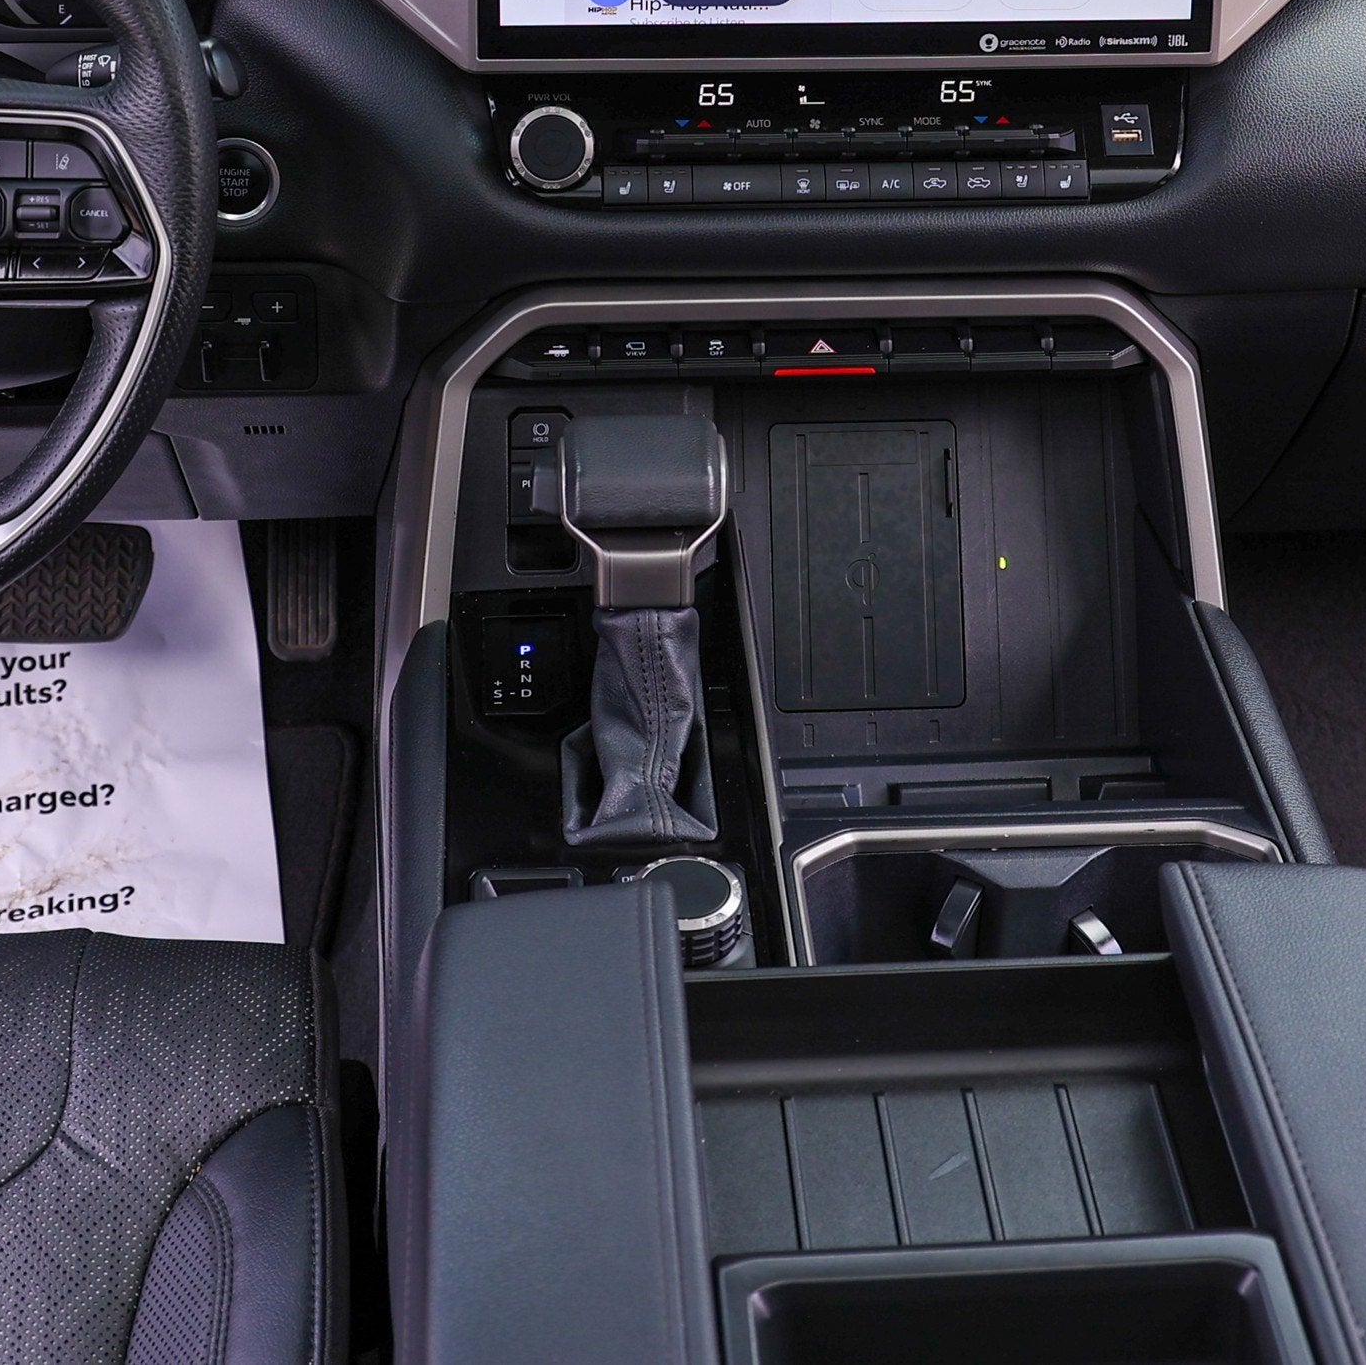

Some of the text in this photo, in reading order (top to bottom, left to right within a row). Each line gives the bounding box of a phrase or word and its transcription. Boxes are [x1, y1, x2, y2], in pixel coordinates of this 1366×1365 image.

[58, 4, 65, 14] E
[1068, 38, 1091, 46] Radio
[1168, 34, 1189, 47] JBL
[81, 79, 91, 87] LO
[698, 83, 735, 106] 65
[939, 80, 975, 103] 65
[528, 93, 572, 102] PWR VOL
[746, 116, 942, 128] AUTO SYNC MODE
[219, 168, 251, 177] ENGINE
[220, 178, 250, 187] START
[733, 179, 900, 191] OFF A/C
[223, 187, 249, 197] STOP
[79, 209, 109, 218] CANCEL
[520, 645, 531, 655] P
[0, 649, 72, 679] your
[520, 660, 531, 669] R
[521, 674, 532, 683] N
[493, 689, 532, 698] S D
